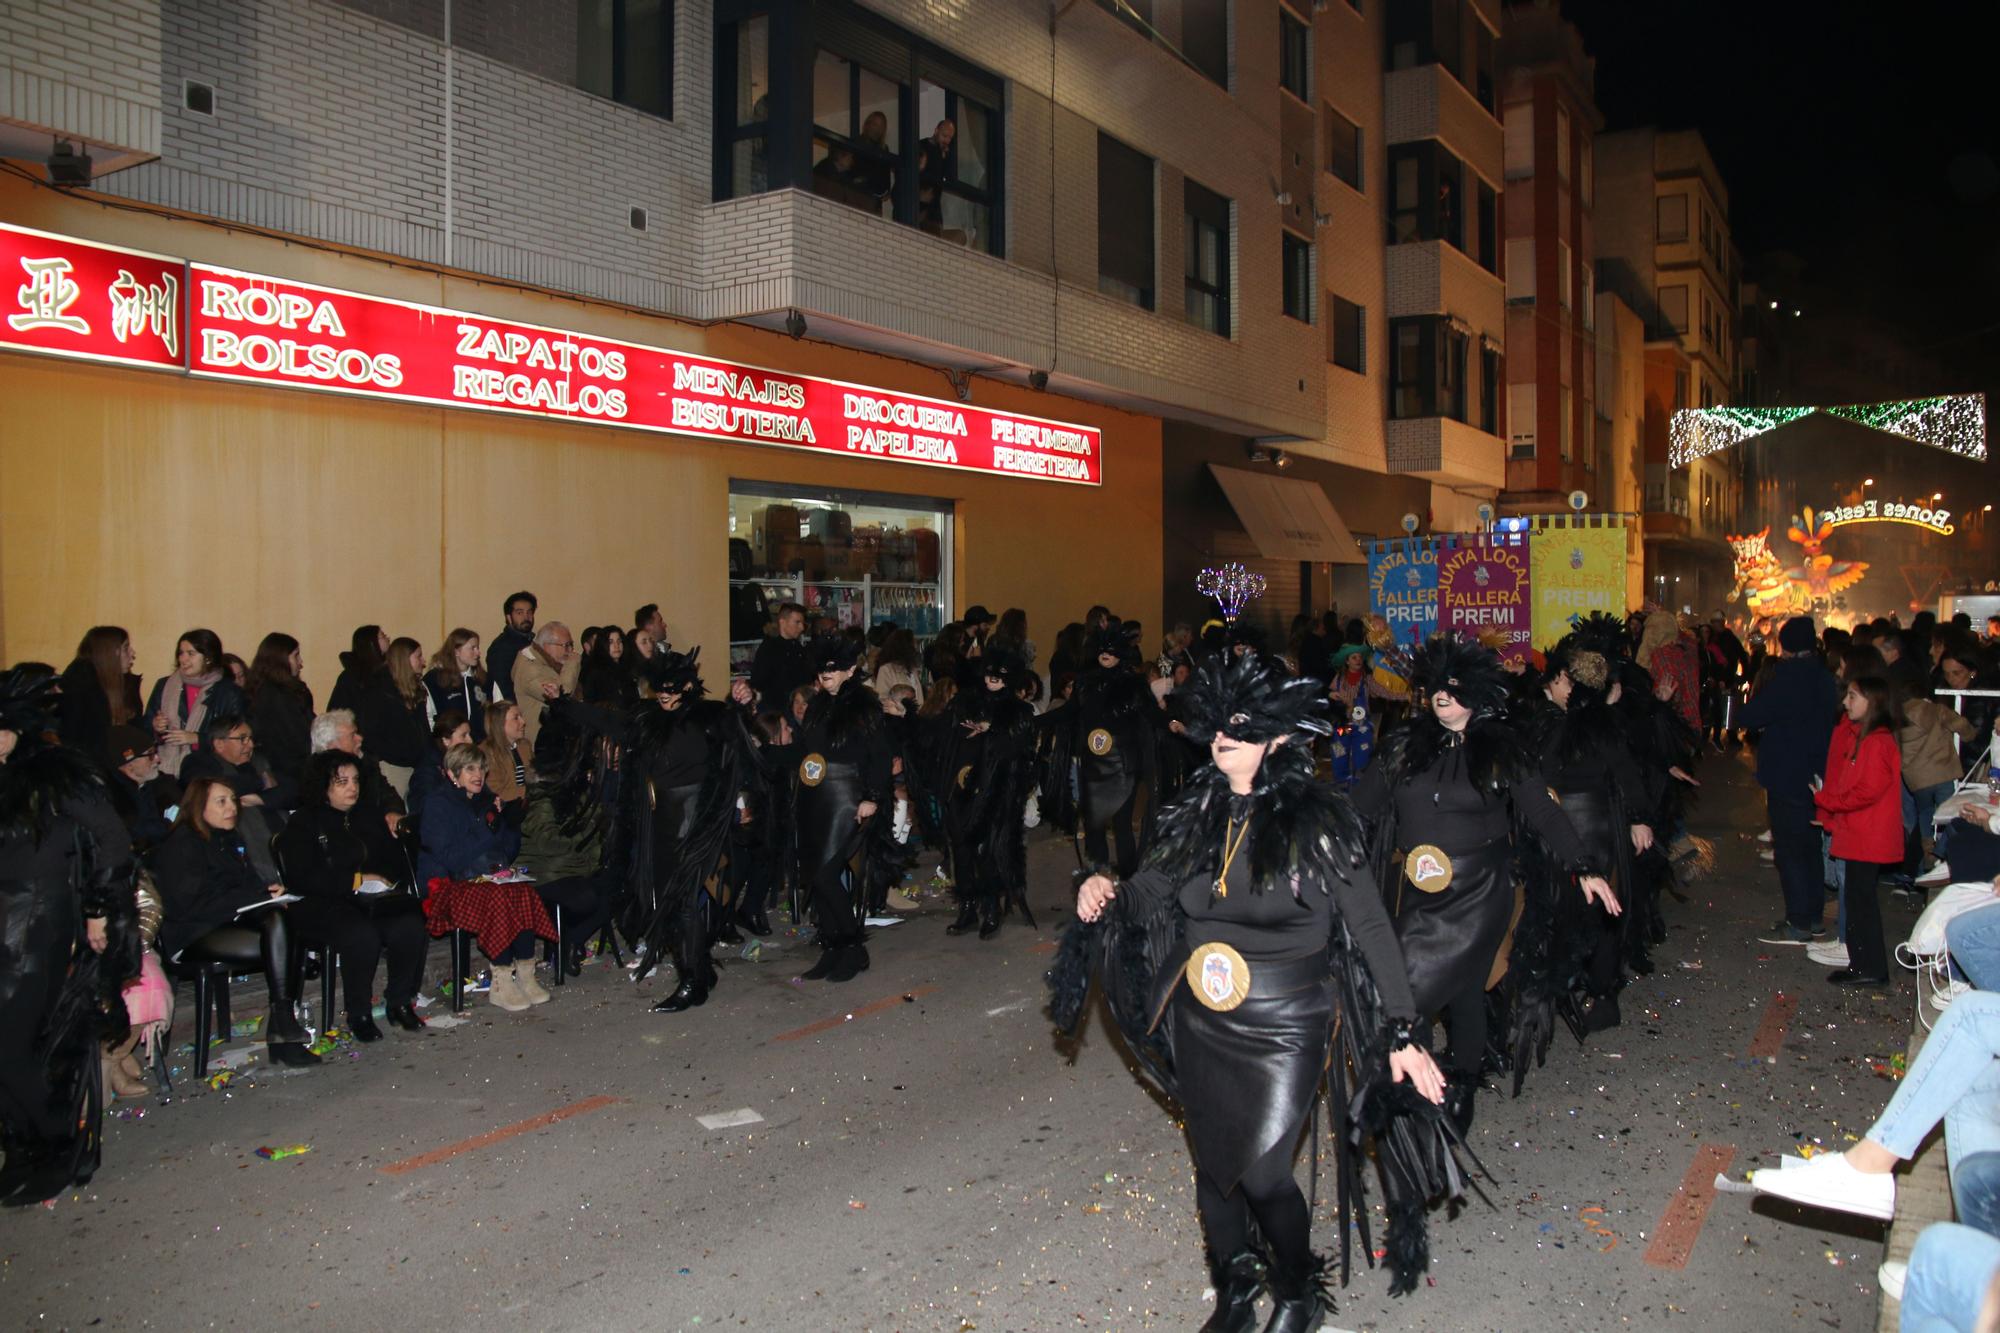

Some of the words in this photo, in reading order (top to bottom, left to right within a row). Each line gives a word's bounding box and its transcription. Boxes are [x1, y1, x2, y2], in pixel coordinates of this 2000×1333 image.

[201, 280, 346, 337] ROPA
[201, 328, 403, 388] BOLSOS
[456, 324, 627, 381] ZAPATOS
[453, 365, 628, 418] REGALOS
[673, 362, 805, 409] MENAJES
[672, 398, 816, 443] BISUTERIA
[843, 393, 968, 437] DROGUERIA
[847, 425, 958, 463] PAPELERIA
[991, 418, 1091, 456] PERFUMERIA
[993, 446, 1090, 480] FERRETERIA
[1370, 552, 1408, 592] JUNTA
[1439, 549, 1478, 593] JUNTA
[1483, 548, 1529, 591] LOCAL
[1539, 573, 1617, 588] FALLERA
[1377, 588, 1438, 607] FALLER
[1386, 604, 1438, 624] PREM
[1446, 590, 1521, 608] FALLERA
[1452, 607, 1514, 625] PREMI
[1543, 587, 1612, 608] PREMI
